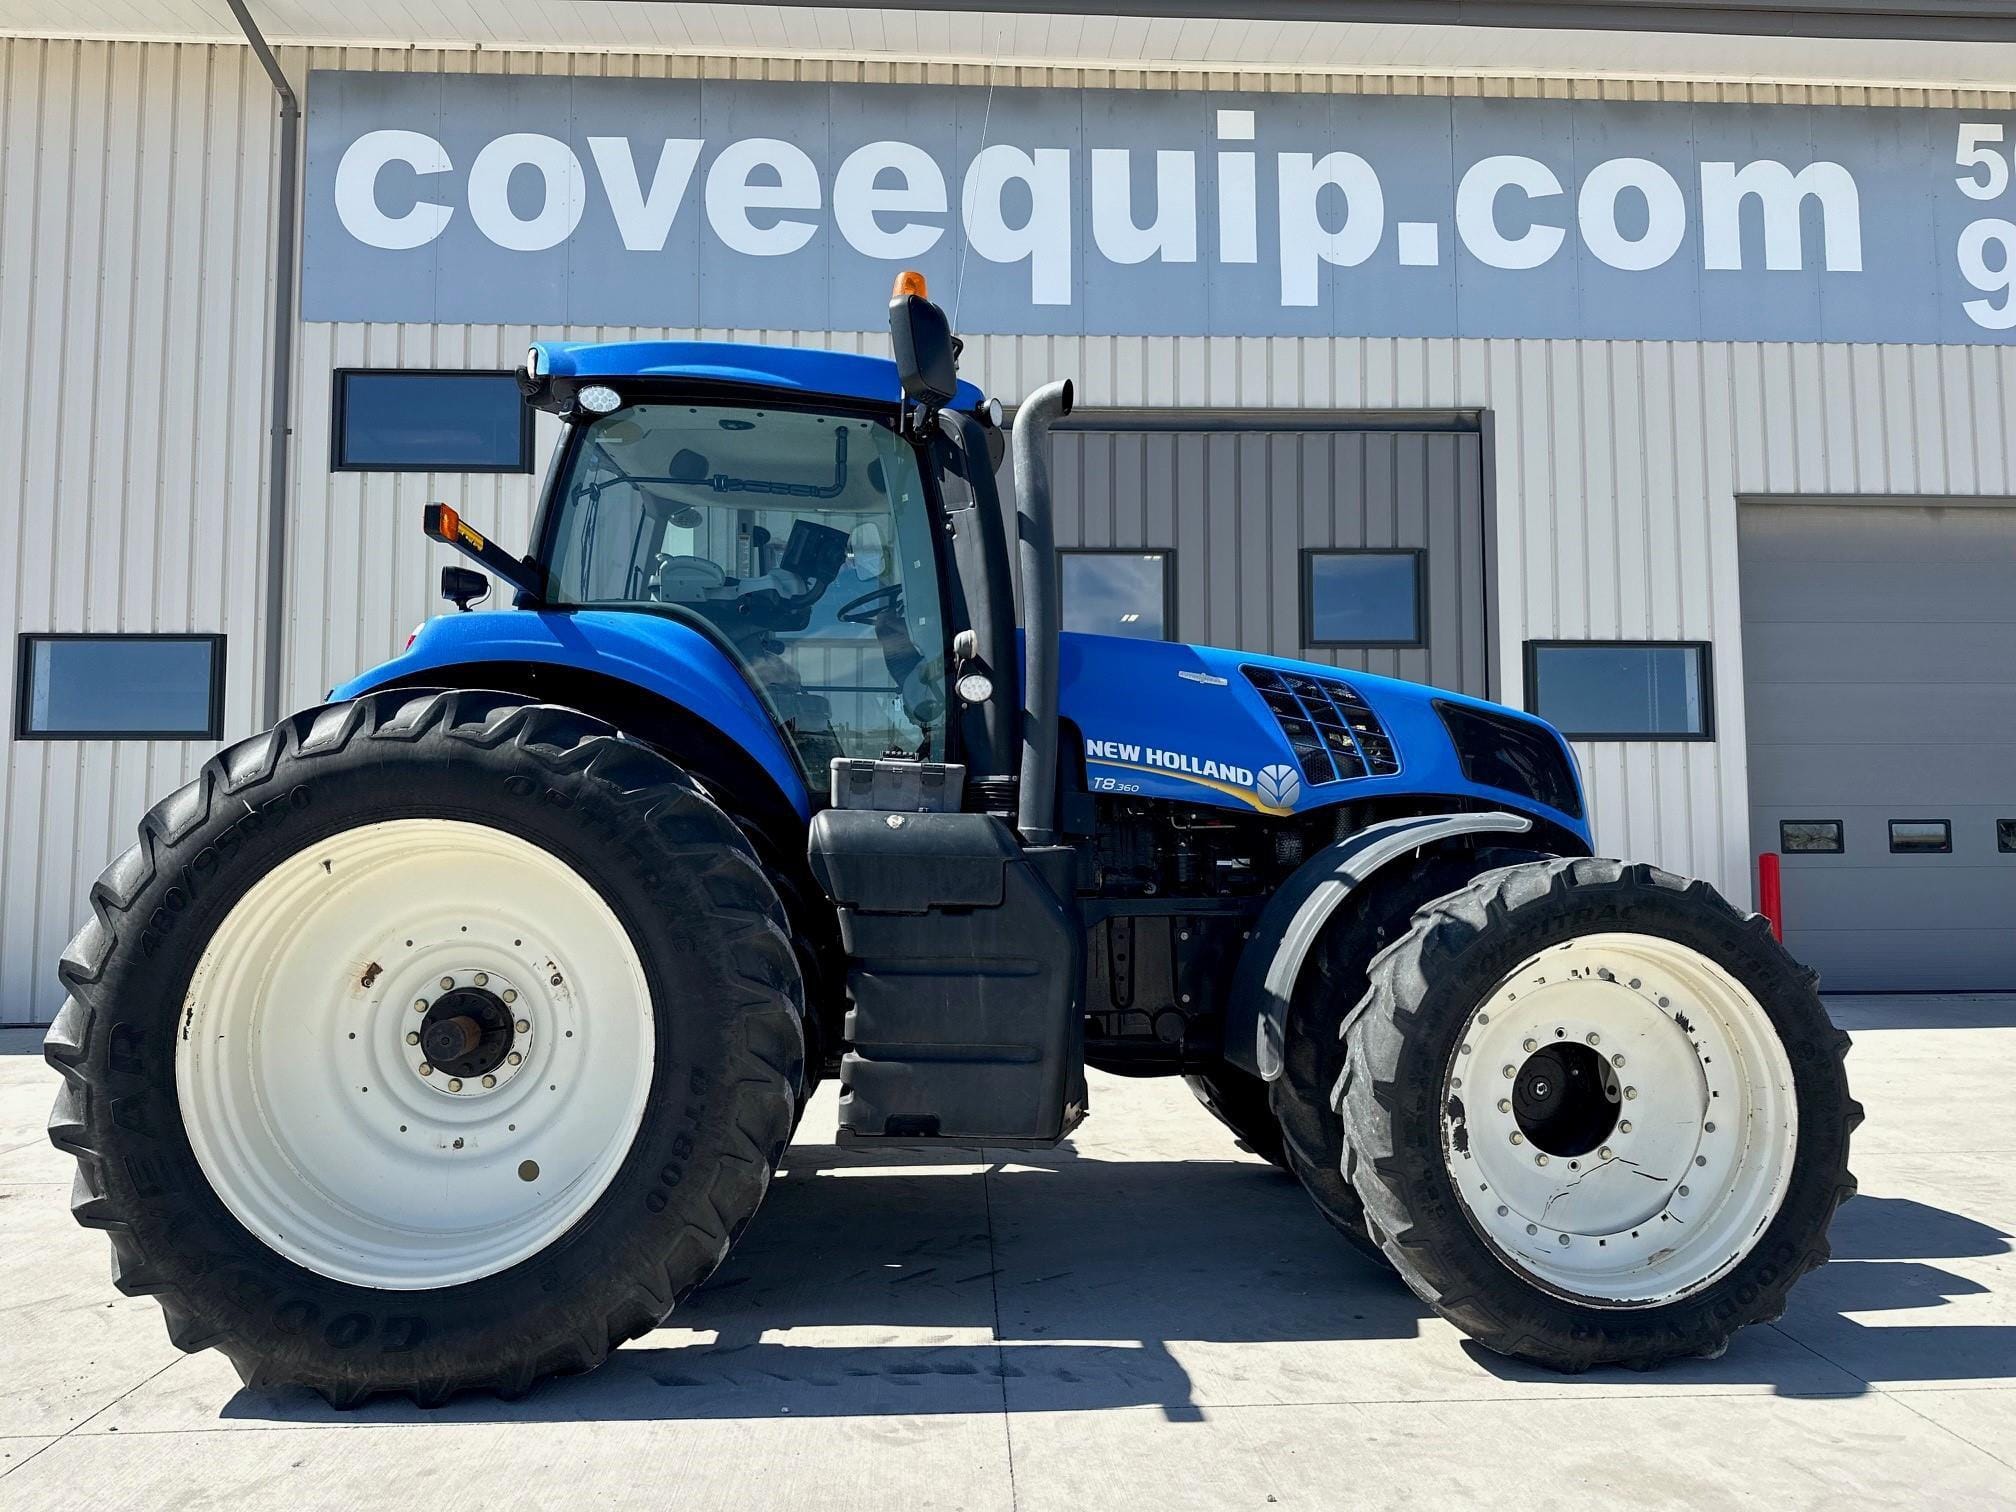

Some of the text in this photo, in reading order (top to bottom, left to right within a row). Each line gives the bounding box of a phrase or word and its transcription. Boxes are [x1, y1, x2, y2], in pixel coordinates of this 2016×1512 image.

[334, 110, 1862, 307] coveequip.com
[1086, 739, 1254, 786] NEW HOLLAND
